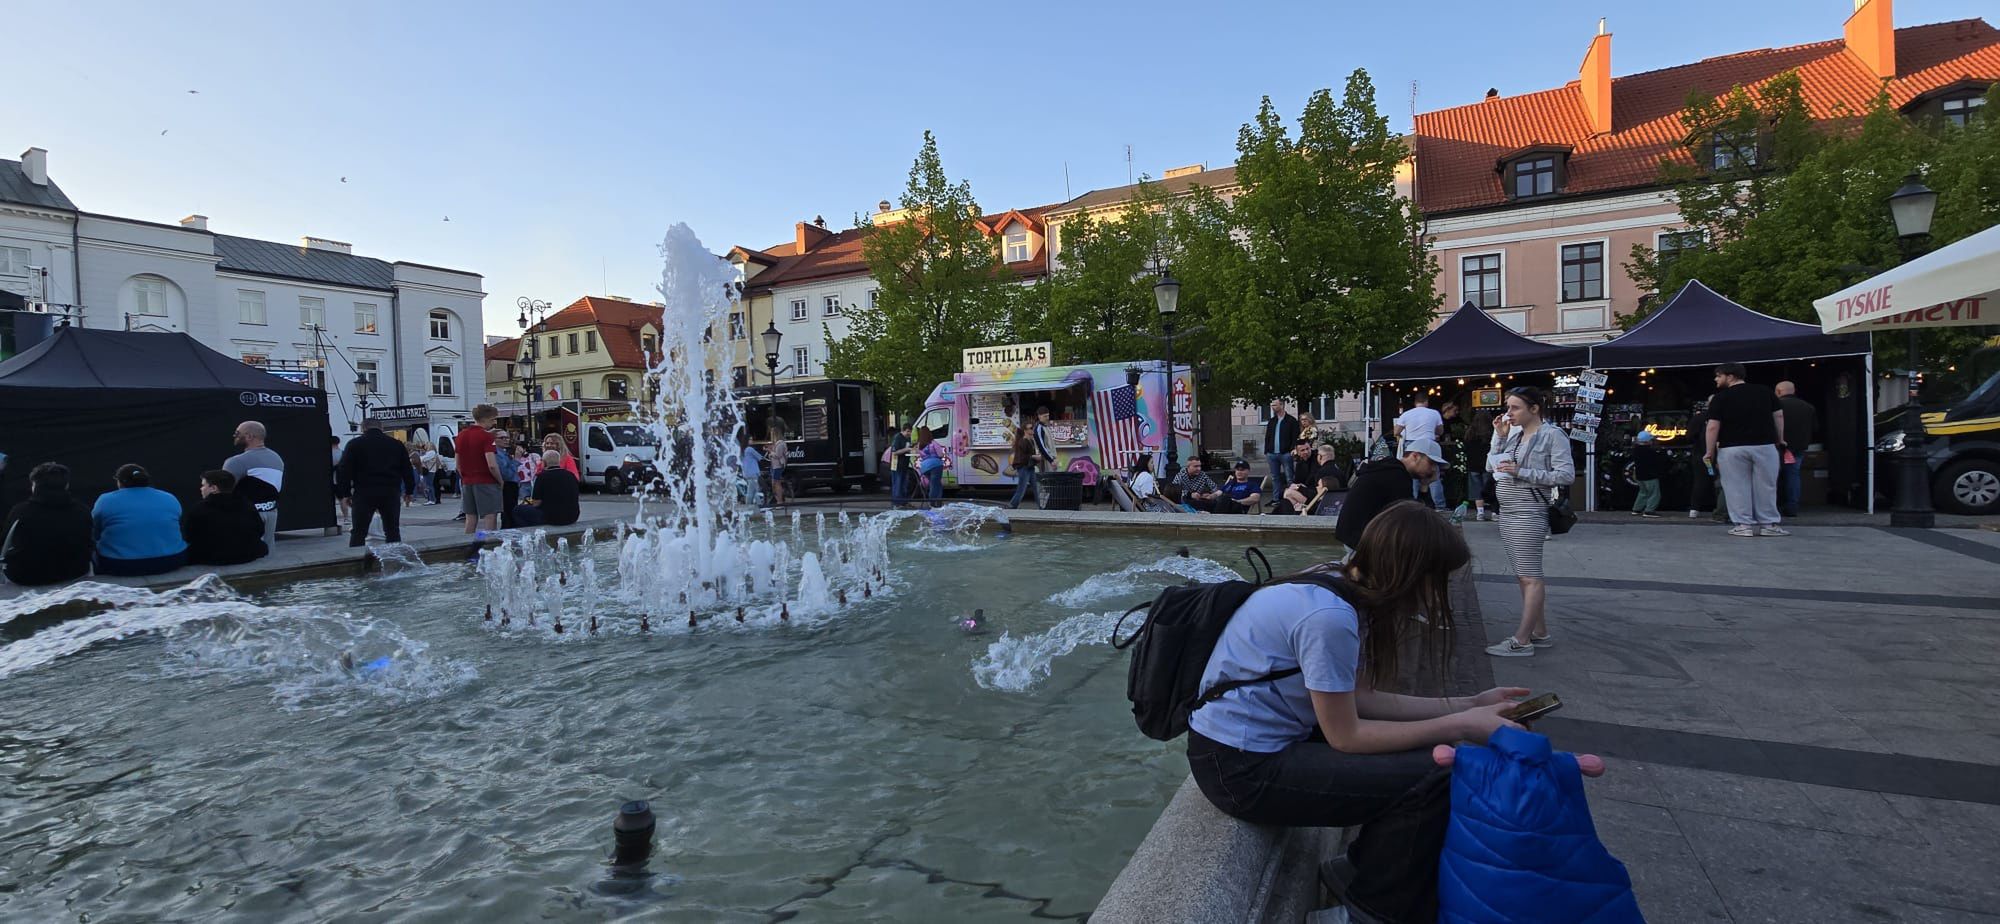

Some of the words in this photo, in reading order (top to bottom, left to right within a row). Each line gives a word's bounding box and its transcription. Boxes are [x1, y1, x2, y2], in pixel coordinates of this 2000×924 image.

[1835, 284, 1893, 322] TYSKIE
[967, 346, 1046, 365] TORTILLA'S
[258, 392, 316, 404] Recon
